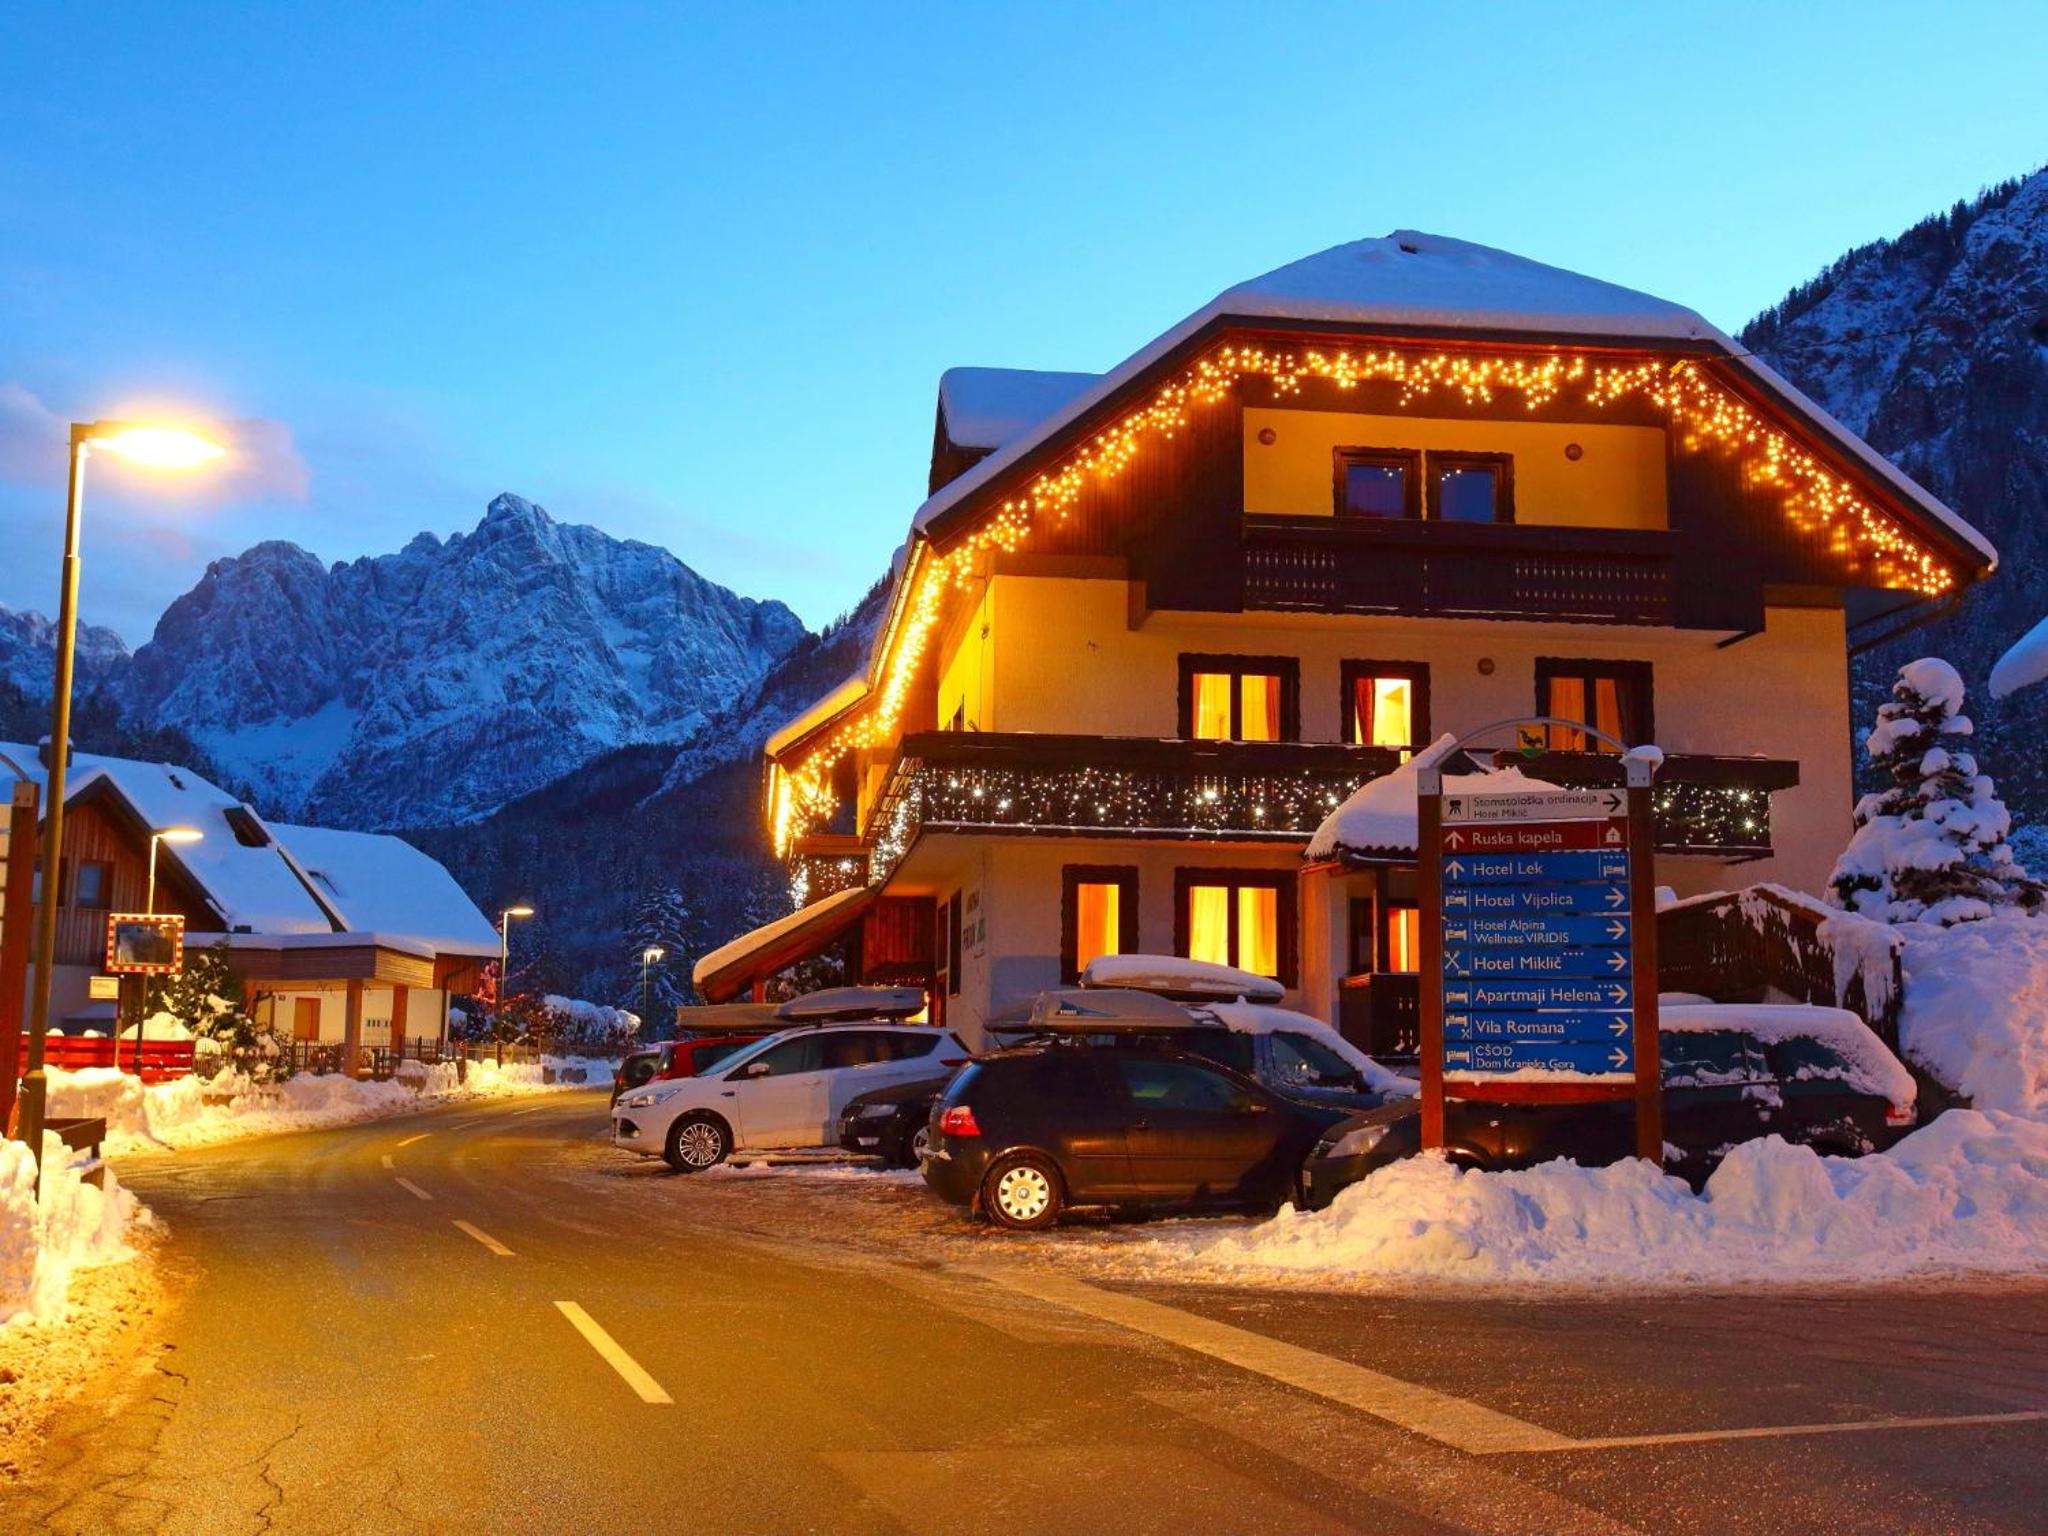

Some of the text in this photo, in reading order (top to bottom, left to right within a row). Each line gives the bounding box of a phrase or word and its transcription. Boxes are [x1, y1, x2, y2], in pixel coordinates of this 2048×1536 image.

[1474, 793, 1598, 808] Stomatološka ordinacija
[1474, 809, 1500, 818] Hotel
[1472, 830, 1562, 848] Ruska kapela
[1473, 862, 1543, 876] Hotel Lek
[1475, 893, 1573, 909] Hotel Vijolica
[1474, 919, 1545, 932] Hotel Alpina
[1474, 932, 1569, 944] Wellness VIRIDIS
[1474, 954, 1562, 970] Hotel Miklič
[1475, 988, 1601, 1005] Apartmaji Helena
[1475, 1020, 1565, 1034] Vila Romana
[1475, 1043, 1513, 1057] CŠOD
[1476, 1058, 1500, 1069] Dom
[1549, 1058, 1575, 1070] Gora
